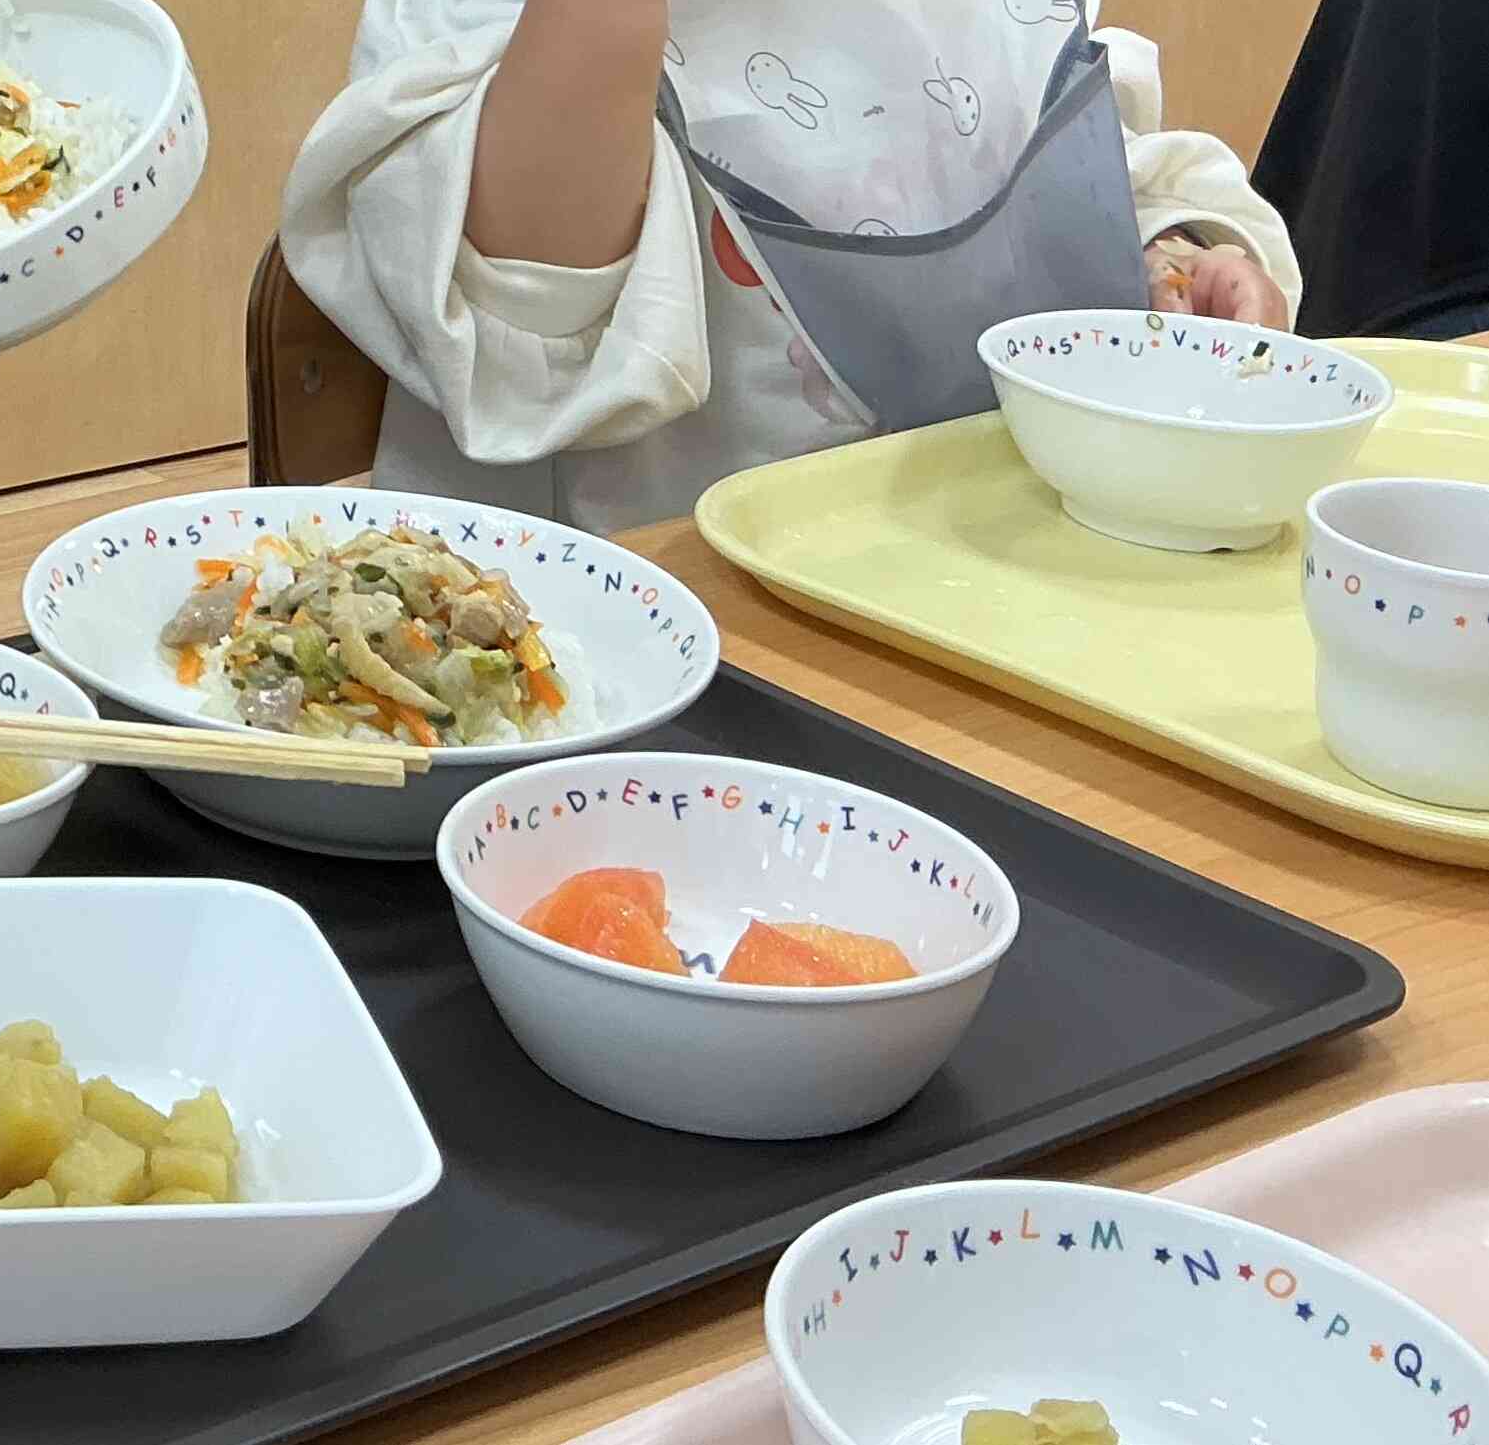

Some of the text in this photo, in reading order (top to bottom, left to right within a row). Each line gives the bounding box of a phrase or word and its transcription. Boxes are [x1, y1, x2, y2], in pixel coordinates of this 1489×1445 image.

[21, 259, 34, 277] C
[66, 226, 83, 243] D
[114, 186, 124, 208] E
[146, 166, 156, 187] F
[1008, 339, 1020, 357] Q
[1033, 336, 1043, 353] R
[1060, 338, 1072, 355] S
[1090, 329, 1104, 345] T
[1129, 341, 1143, 356] U
[1172, 330, 1186, 346] V
[1212, 339, 1233, 358] W
[1326, 364, 1338, 381] Z
[145, 528, 157, 548] R
[186, 525, 201, 545] S
[228, 510, 243, 527] T
[342, 503, 356, 521] V
[461, 522, 477, 542] X
[518, 529, 534, 547] Y
[562, 543, 576, 562] Z
[605, 572, 621, 592] N
[642, 588, 658, 605] O
[1345, 575, 1360, 594] O
[1408, 605, 1424, 624] P
[0, 673, 16, 699] Q
[496, 804, 506, 828] B
[528, 806, 539, 830] C
[567, 791, 586, 813] D
[622, 779, 642, 805] E
[672, 794, 688, 820] F
[722, 785, 741, 809] G
[778, 807, 804, 835] H
[841, 807, 855, 830] I
[888, 829, 909, 851] J
[930, 860, 944, 886] K
[812, 1208, 1470, 1436] H I J K L M N O P Q R
